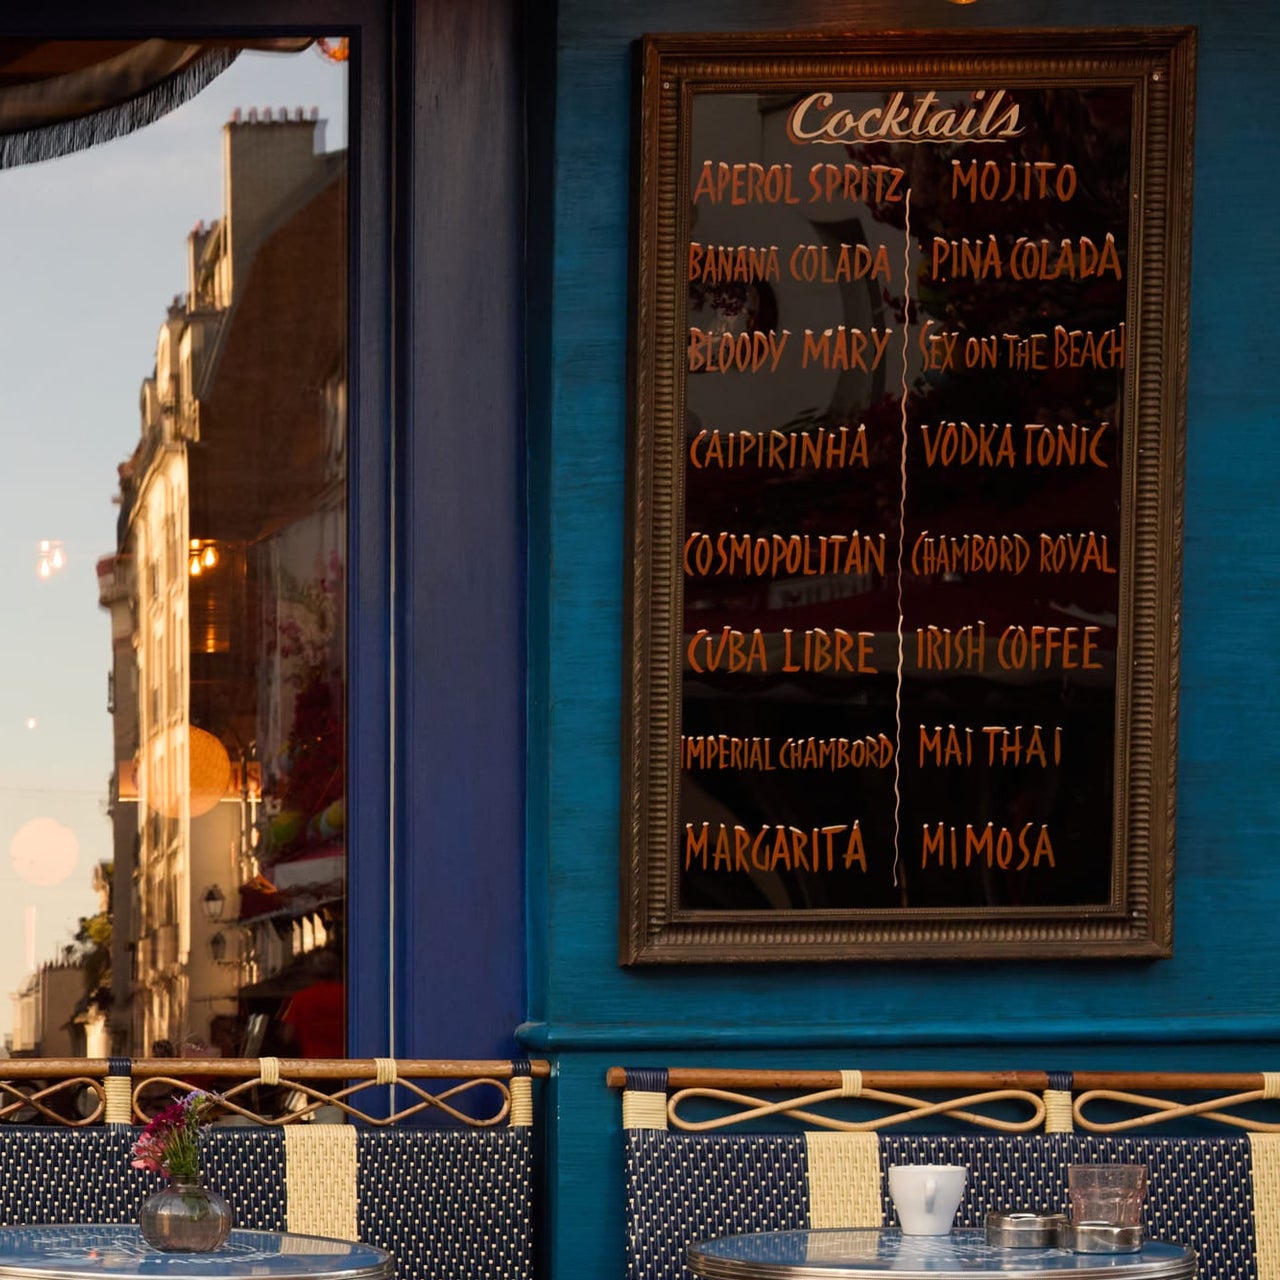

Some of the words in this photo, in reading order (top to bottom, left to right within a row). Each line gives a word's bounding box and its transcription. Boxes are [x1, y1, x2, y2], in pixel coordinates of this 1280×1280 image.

[786, 89, 1024, 143] Cocktails
[692, 160, 801, 206] APEROL
[808, 162, 904, 204] SPRITZ
[952, 159, 1076, 202] MOJITO
[688, 242, 780, 284] BANANA
[790, 243, 892, 283] COLADA
[933, 234, 1001, 282] PINA
[1010, 232, 1121, 280] COLADA
[688, 324, 790, 374] BLOODY
[802, 325, 892, 372] MARY
[919, 319, 958, 371] SEX
[965, 335, 997, 368] ON
[1003, 333, 1047, 369] THE
[1055, 322, 1128, 368] BEACH
[690, 424, 868, 469] CAIPIRINHA
[922, 421, 1015, 467] VODKA
[1025, 422, 1108, 467] TONIC
[683, 530, 886, 576] COSMOPOLITAN
[912, 531, 1030, 577] CHAMBORD
[1040, 531, 1117, 574] ROYAL
[687, 626, 767, 673] CUBA
[782, 627, 877, 673] LIBRE
[917, 620, 985, 671] IRISH
[998, 625, 1102, 670] COFFEE
[680, 735, 774, 770] IMPERIAL
[780, 733, 893, 770] CHAMBORD
[920, 724, 971, 767] MAI
[982, 725, 1060, 767] THAI
[686, 820, 866, 872] MARGARITA
[922, 822, 1054, 870] MIMOSA
